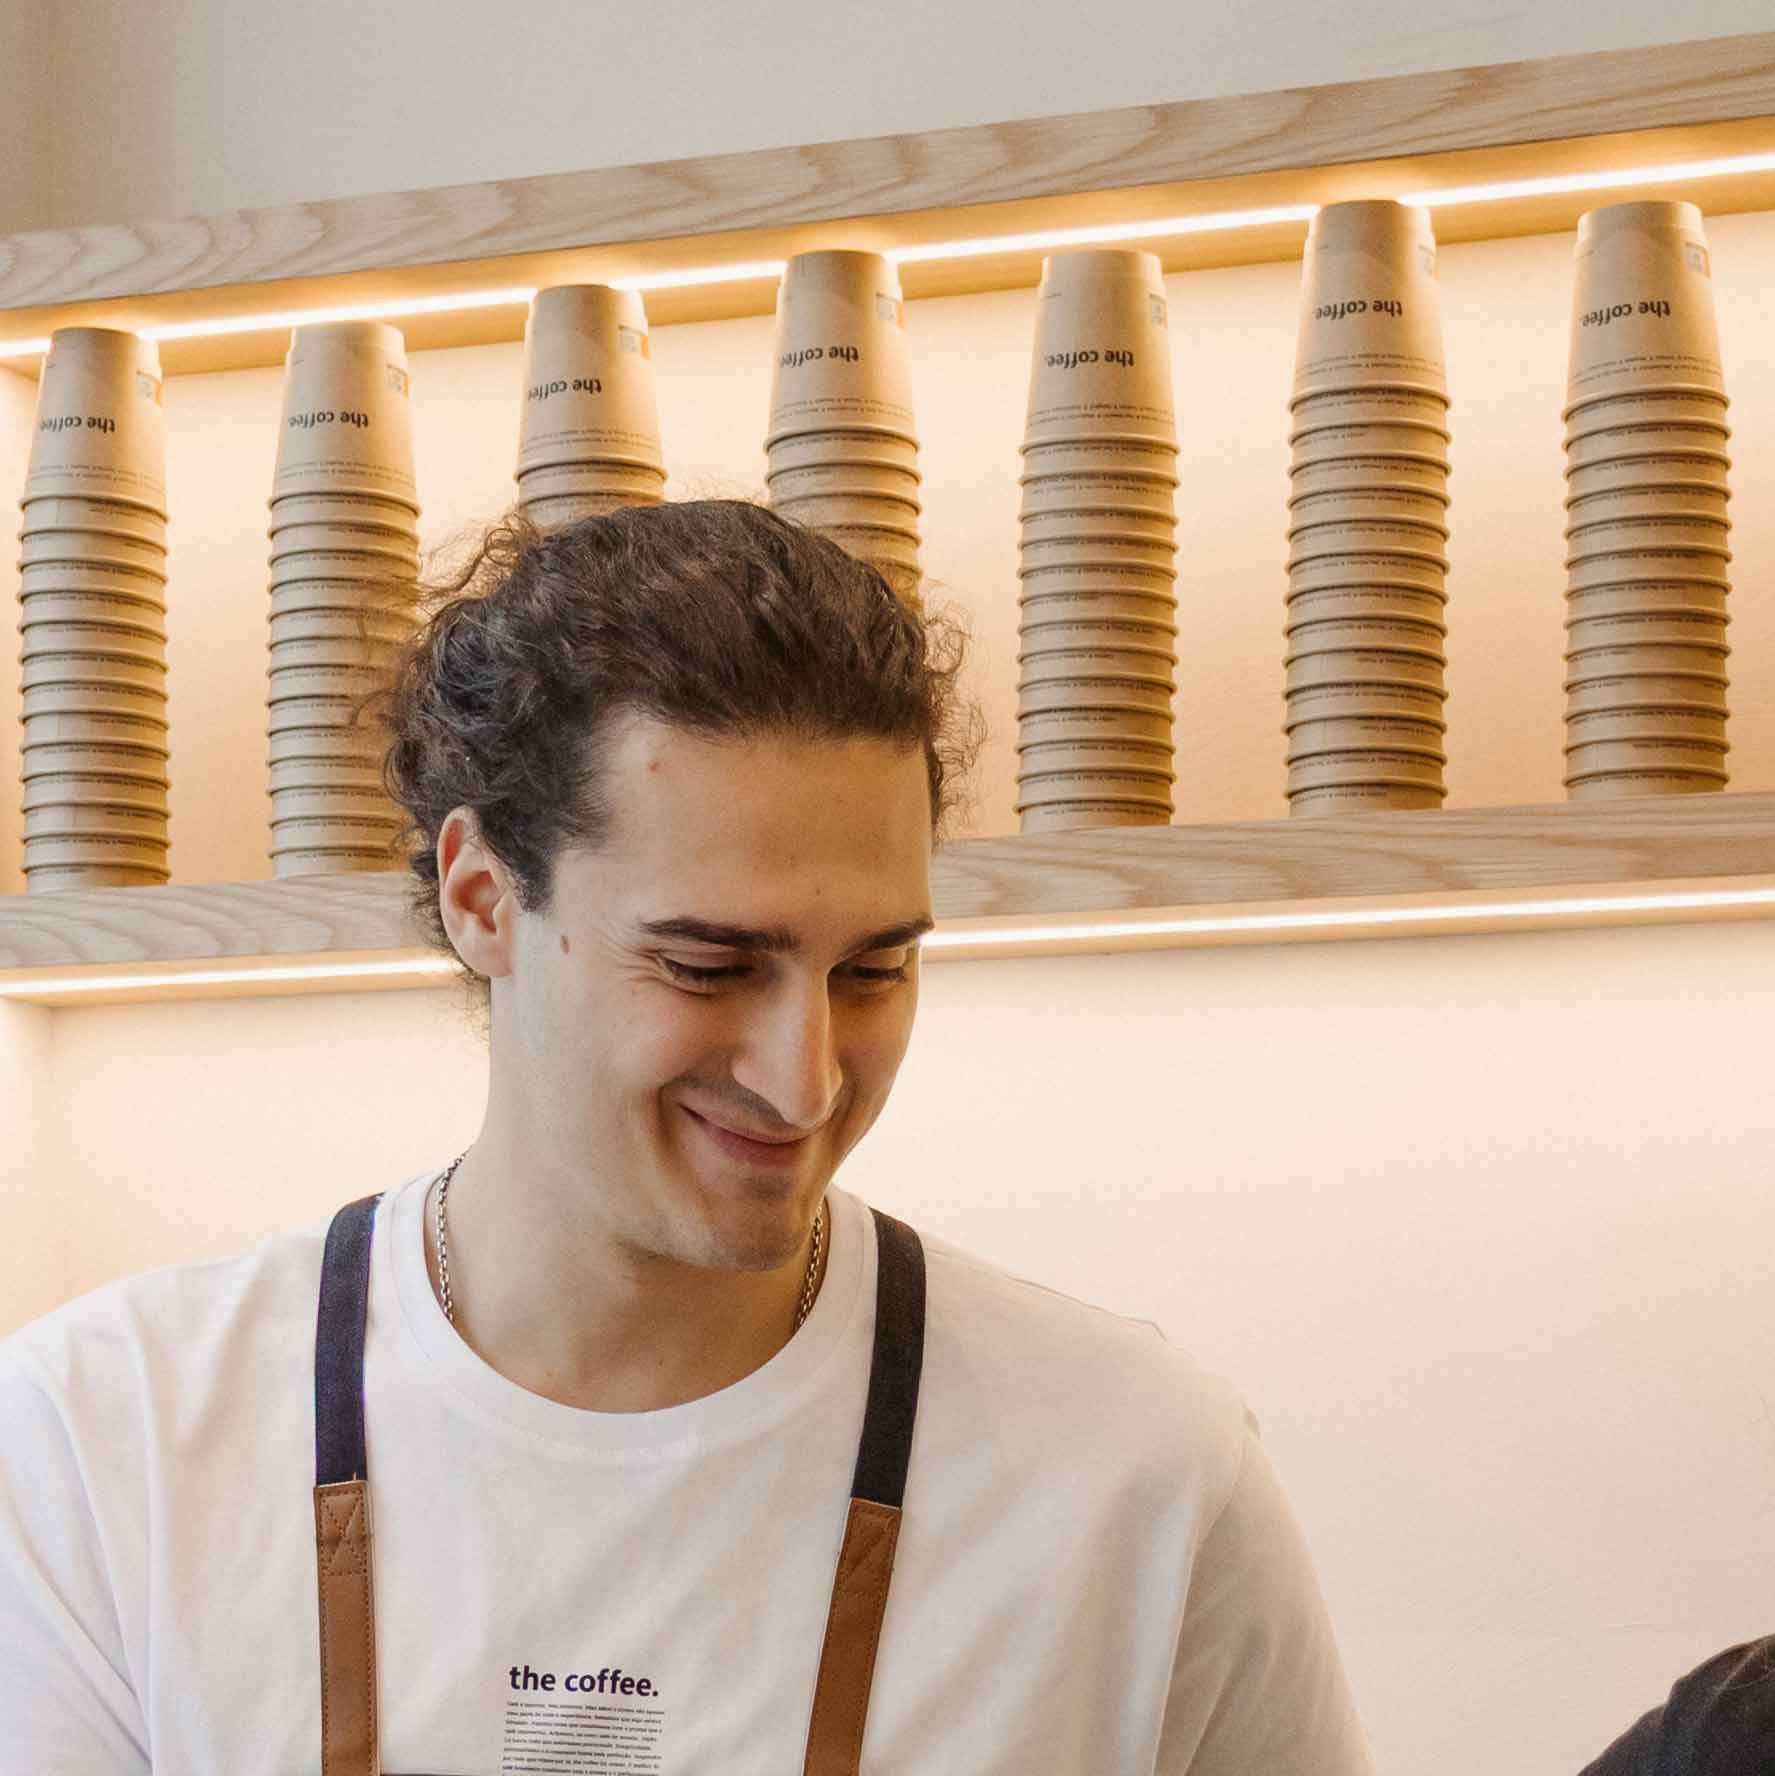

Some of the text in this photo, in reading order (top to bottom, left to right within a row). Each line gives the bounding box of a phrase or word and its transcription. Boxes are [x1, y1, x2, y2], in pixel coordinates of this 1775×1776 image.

[1372, 299, 1403, 317] the
[1638, 300, 1672, 318] the
[828, 345, 860, 362] the
[1104, 349, 1135, 367] the
[572, 377, 603, 395] the
[86, 416, 116, 433] the
[339, 410, 369, 428] the
[508, 1664, 660, 1697] the coffee.
